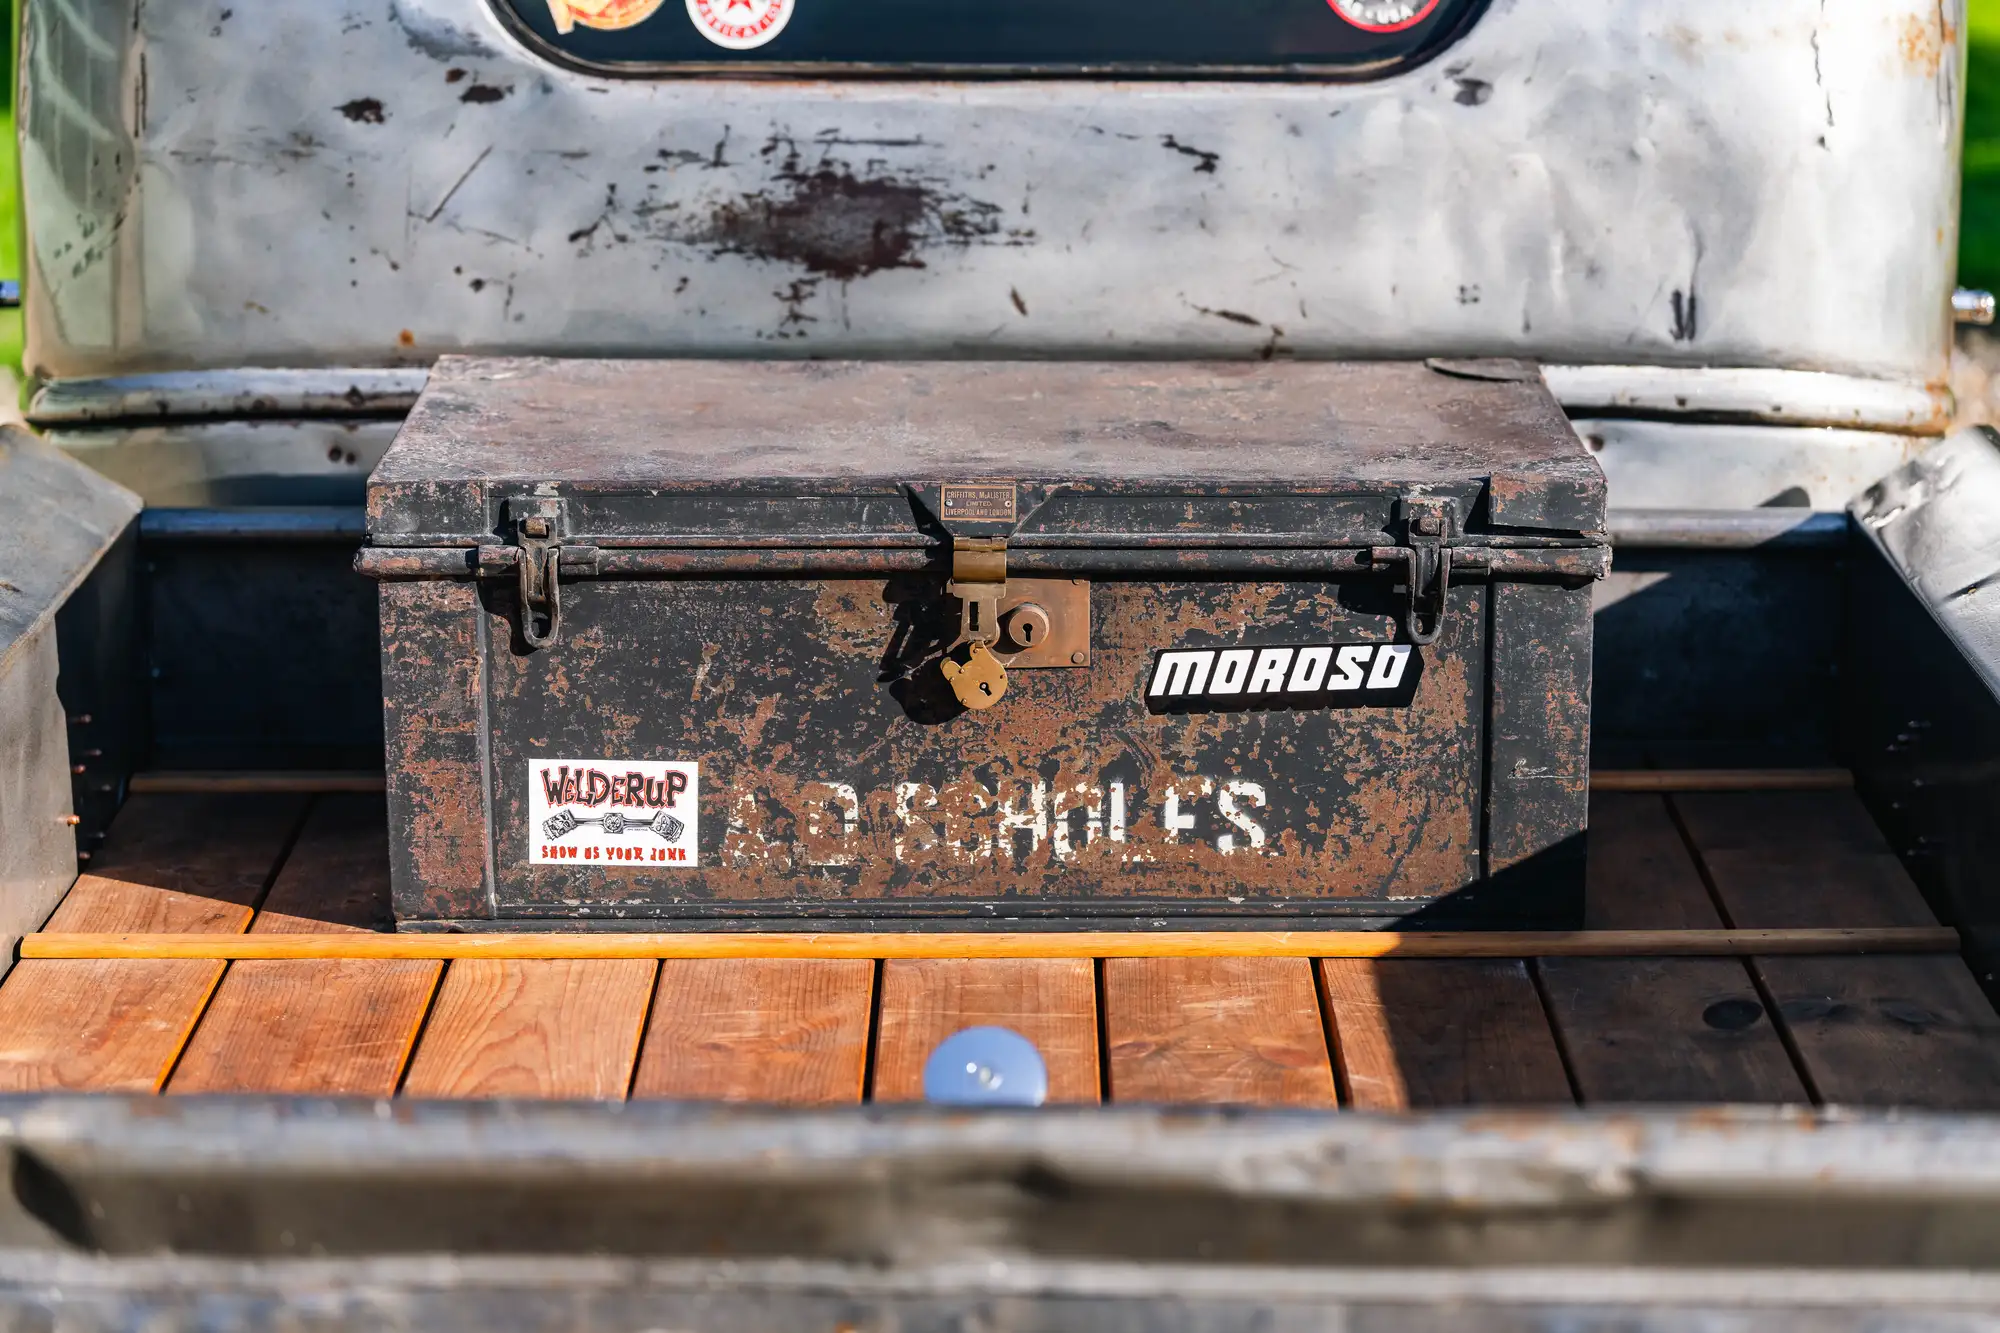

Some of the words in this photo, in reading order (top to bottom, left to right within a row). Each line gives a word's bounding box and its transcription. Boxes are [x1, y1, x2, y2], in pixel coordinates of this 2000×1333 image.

[945, 508, 975, 516] LIVERPOOL
[1149, 644, 1412, 697] MOROSO
[540, 765, 689, 809] WELDERUP
[541, 845, 578, 859] SHOW
[584, 846, 600, 860] US
[605, 846, 644, 861] YOUR
[650, 847, 687, 861] JUNK
